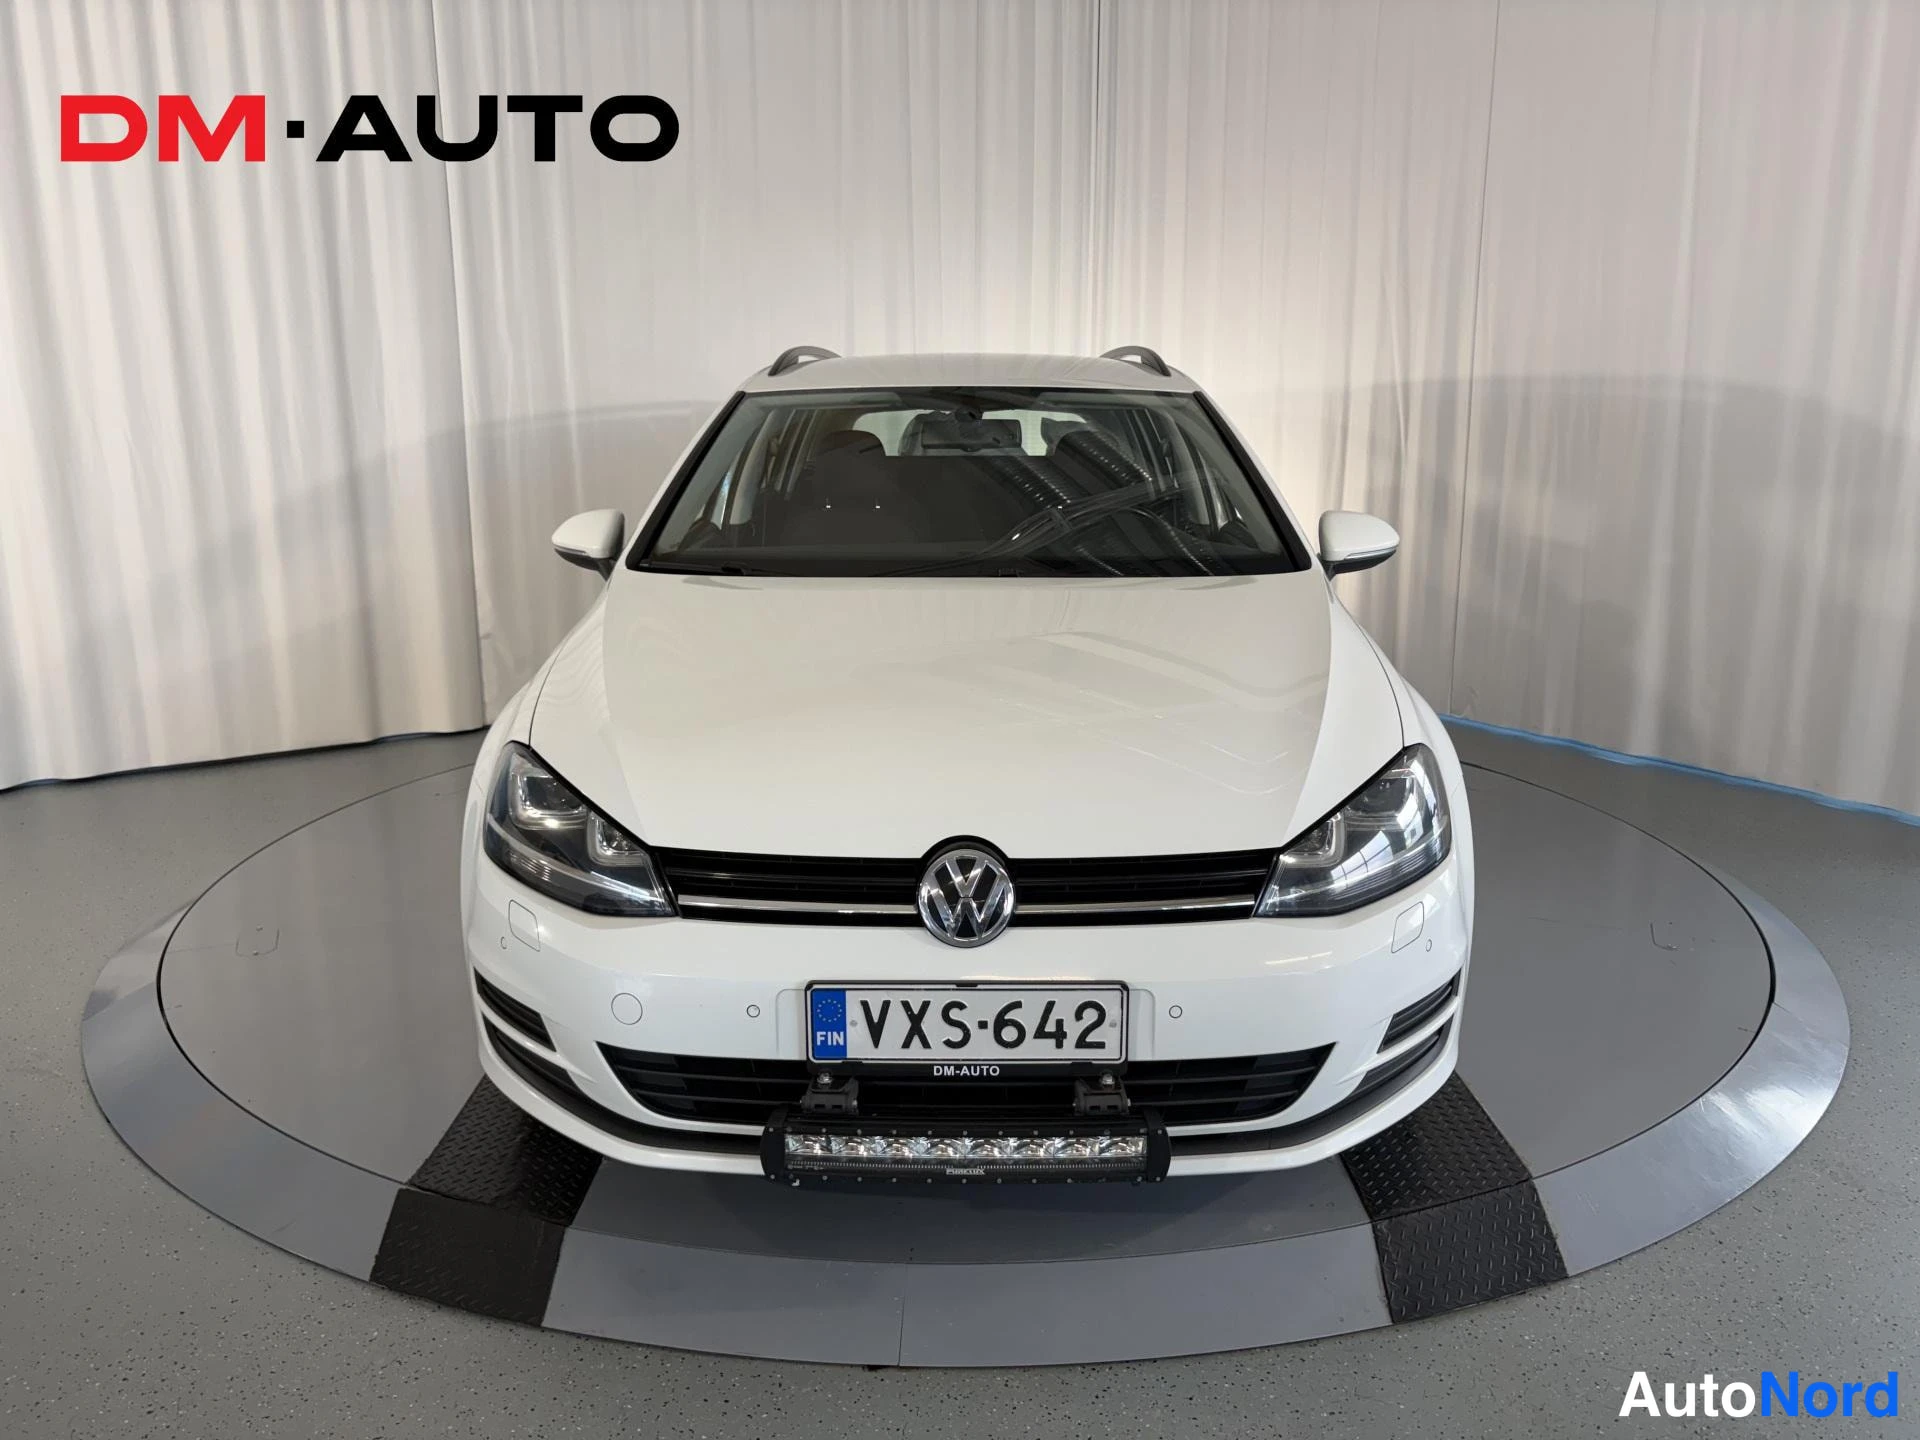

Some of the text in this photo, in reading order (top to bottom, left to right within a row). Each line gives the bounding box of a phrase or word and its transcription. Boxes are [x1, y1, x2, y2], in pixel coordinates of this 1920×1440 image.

[859, 999, 1107, 1049] VXS-642
[816, 1031, 845, 1046] FIN
[933, 1065, 1000, 1076] DM-AUTO
